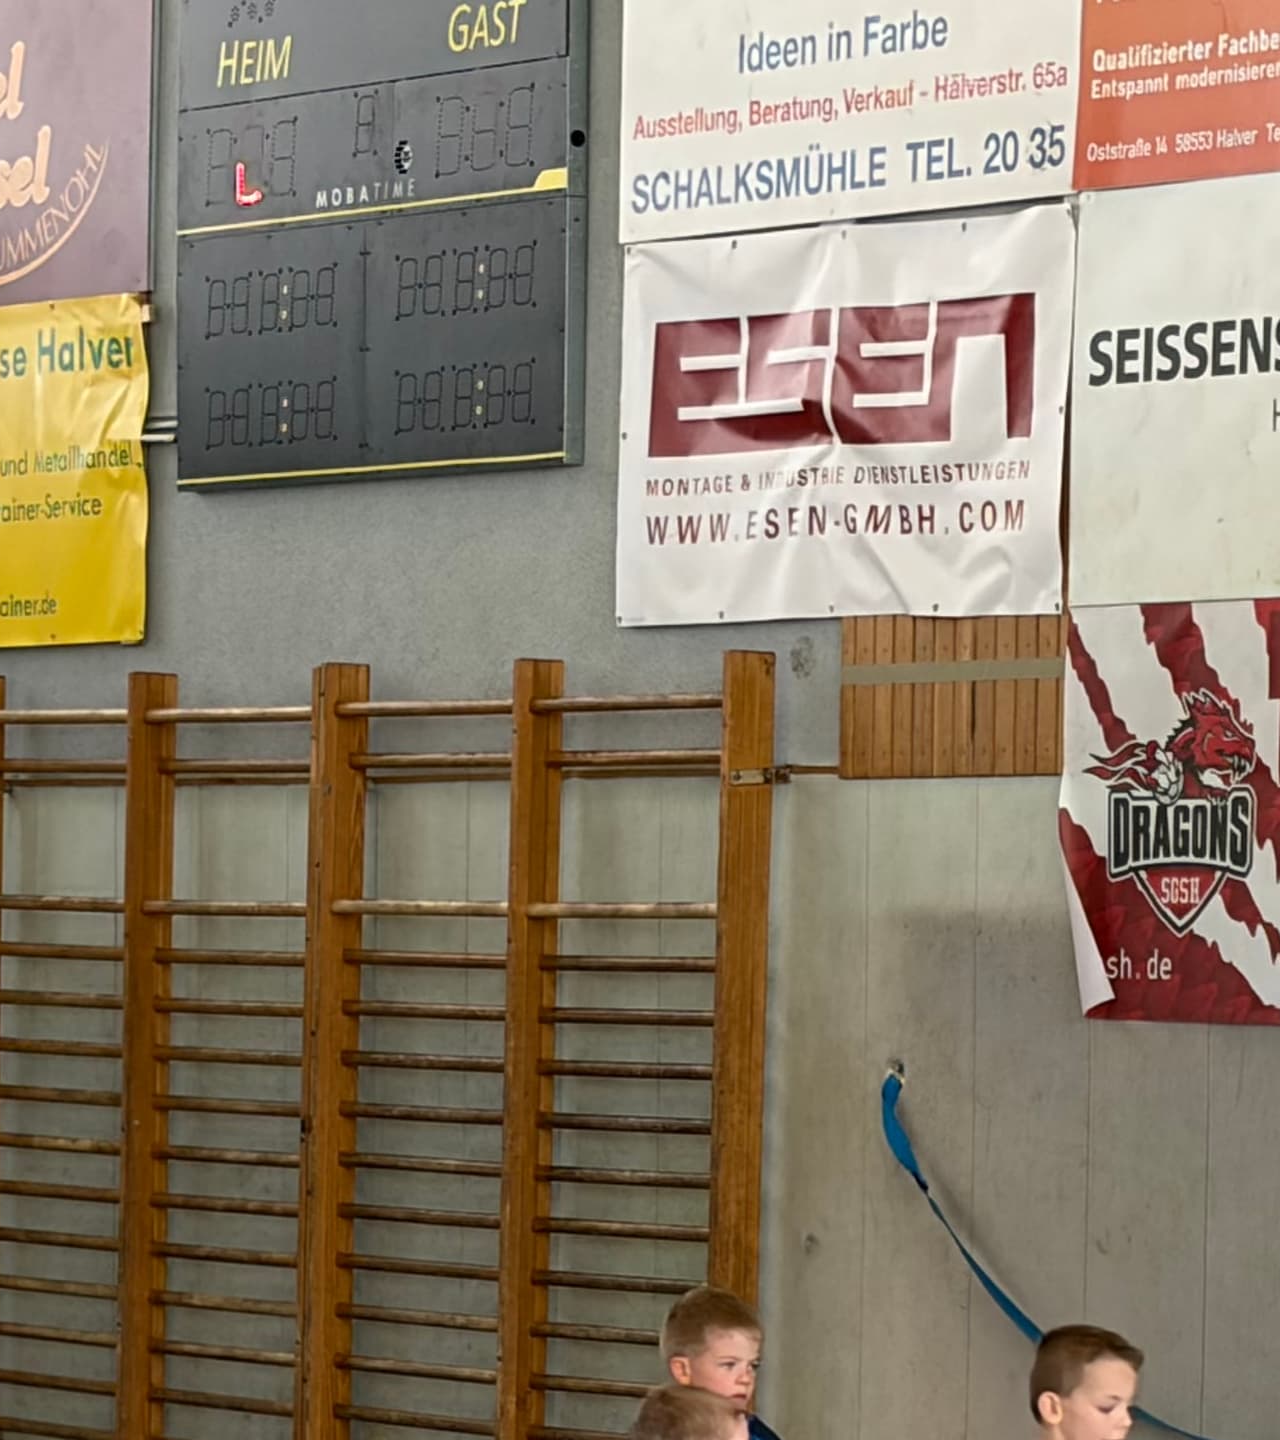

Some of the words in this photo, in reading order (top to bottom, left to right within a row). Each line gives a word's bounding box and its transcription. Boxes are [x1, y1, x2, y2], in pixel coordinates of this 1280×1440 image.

[448, 0, 523, 53] GAST
[738, 32, 817, 74] Ideen
[828, 22, 852, 61] in
[863, 10, 949, 57] Farbe
[217, 35, 292, 87] HEIM
[1093, 39, 1213, 73] Qualifizierter
[633, 107, 743, 140] Ausstellung,
[749, 95, 838, 128] Beratung,
[843, 81, 915, 114] Verkauf
[1032, 62, 1068, 89] 65a
[1091, 72, 1169, 101] Entspannt
[1087, 137, 1152, 162] Oststraße
[1216, 128, 1259, 148] Halver
[630, 143, 888, 214] SCHALKSMÜHLE
[906, 137, 972, 183] TEL.
[984, 129, 1020, 175] 20
[1028, 125, 1066, 169] 35
[316, 178, 416, 208] MOBATIME
[0, 451, 28, 477] und
[646, 474, 734, 496] MONTAGE
[740, 473, 751, 491] &
[758, 466, 845, 491] INUSTRIE
[853, 460, 1031, 486] DIENSTLEISTUNGEN
[1111, 790, 1252, 873] DRAGONS
[1160, 876, 1201, 906] SGSH
